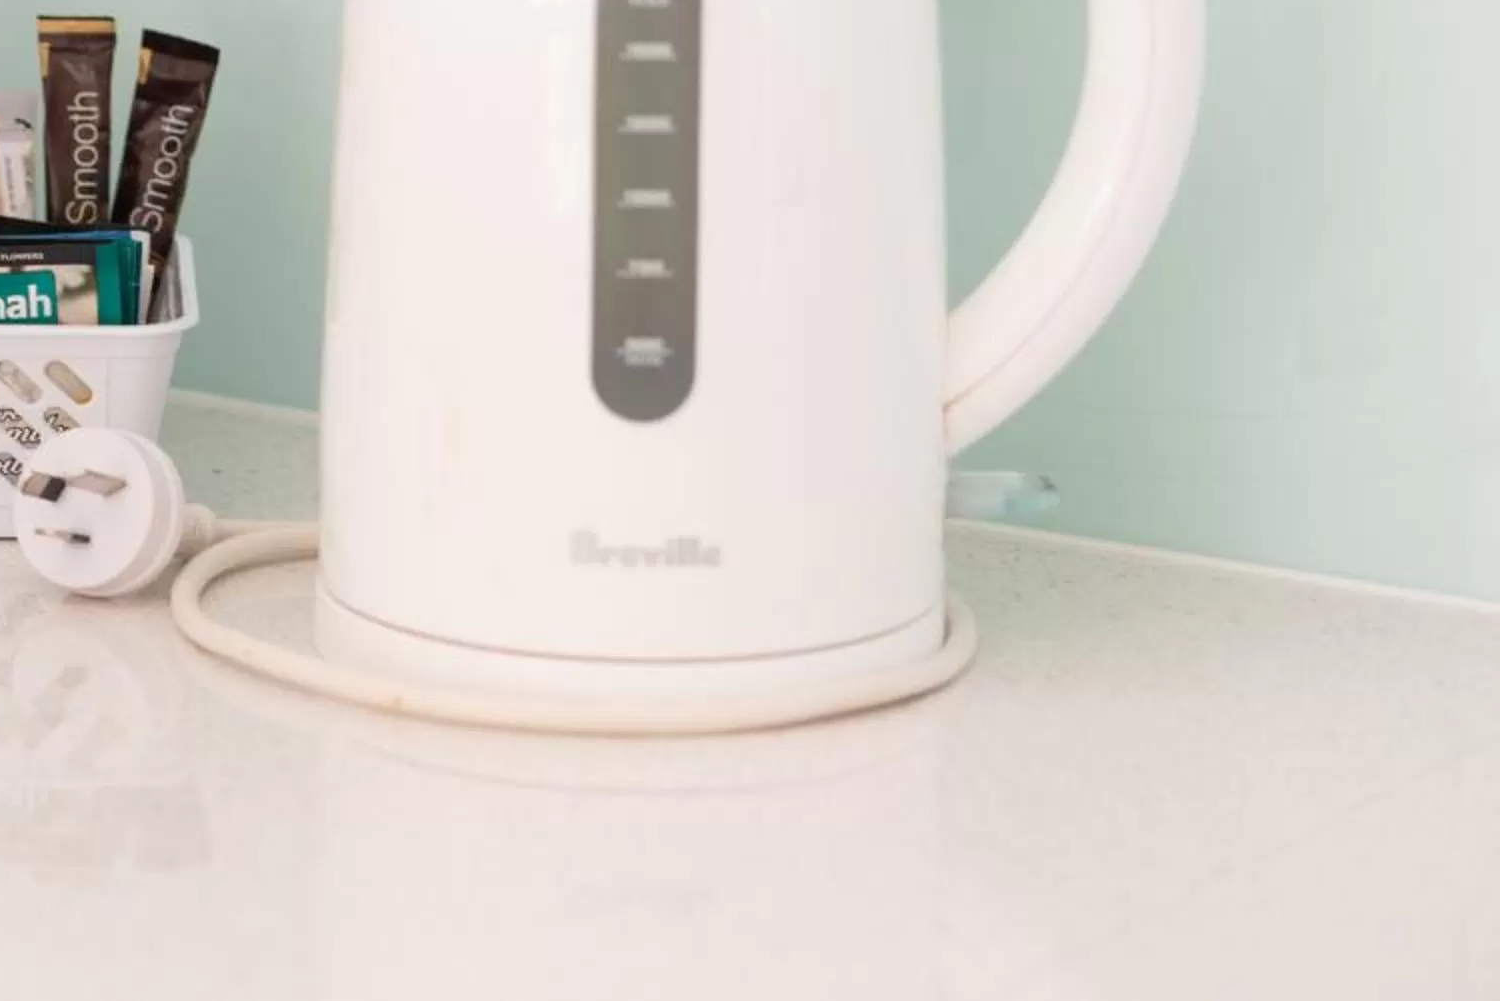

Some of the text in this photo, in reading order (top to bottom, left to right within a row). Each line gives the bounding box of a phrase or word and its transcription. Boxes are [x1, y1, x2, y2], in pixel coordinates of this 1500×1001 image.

[65, 91, 100, 225] Smooth
[129, 104, 197, 234] Smooth
[568, 530, 723, 568] Breville
